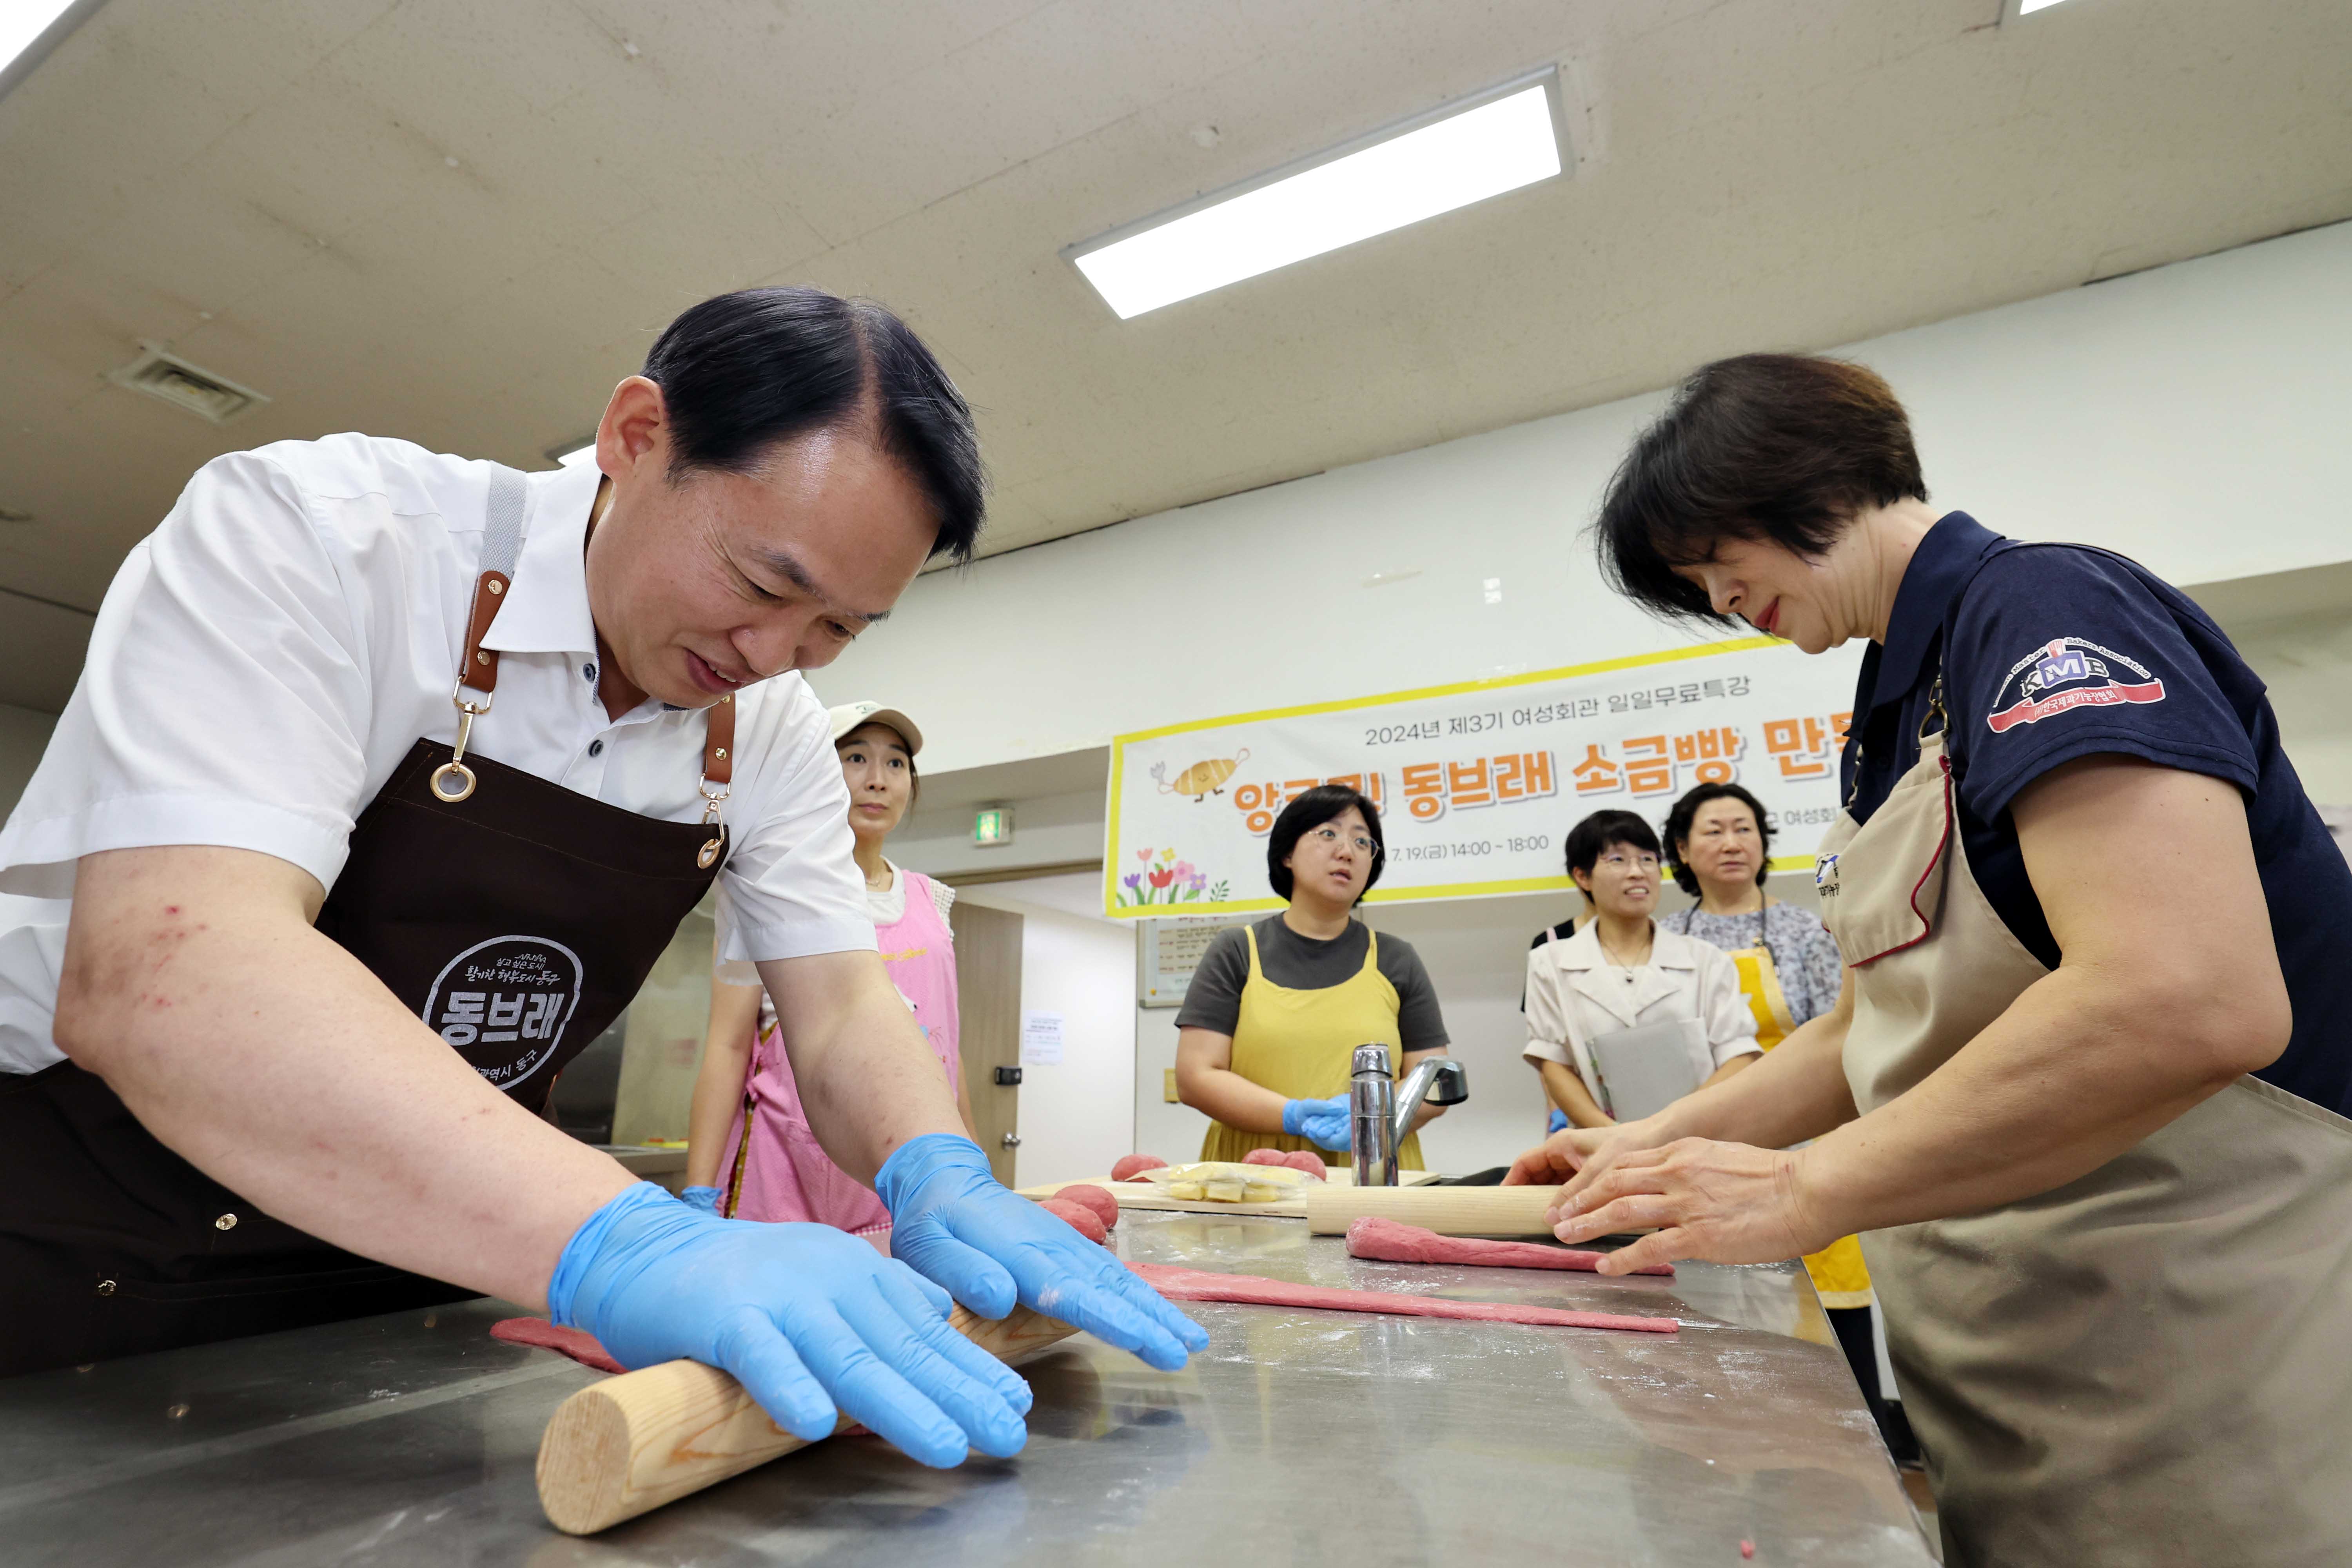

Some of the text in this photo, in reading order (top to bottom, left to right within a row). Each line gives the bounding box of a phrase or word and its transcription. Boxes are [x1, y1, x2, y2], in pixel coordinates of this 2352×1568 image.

[2013, 648, 2045, 673] Master
[2066, 638, 2096, 650] Bakers
[2099, 647, 2150, 678] Association
[2022, 659, 2107, 695] KMB
[1365, 675, 1751, 746] 2024년 제3기 여성회관 일일무료특강
[1403, 751, 1551, 818] 동브래
[1573, 727, 1740, 793] 소금빵
[1784, 807, 1838, 826] 여성회
[1451, 840, 1492, 857] 14:00
[1507, 835, 1549, 852] 18:00
[465, 965, 495, 982] 활기찬
[535, 970, 561, 985] 동구
[496, 958, 511, 966] 살고
[512, 960, 527, 969] 싶은
[440, 991, 565, 1046] 동브래
[516, 1049, 537, 1071] 동구
